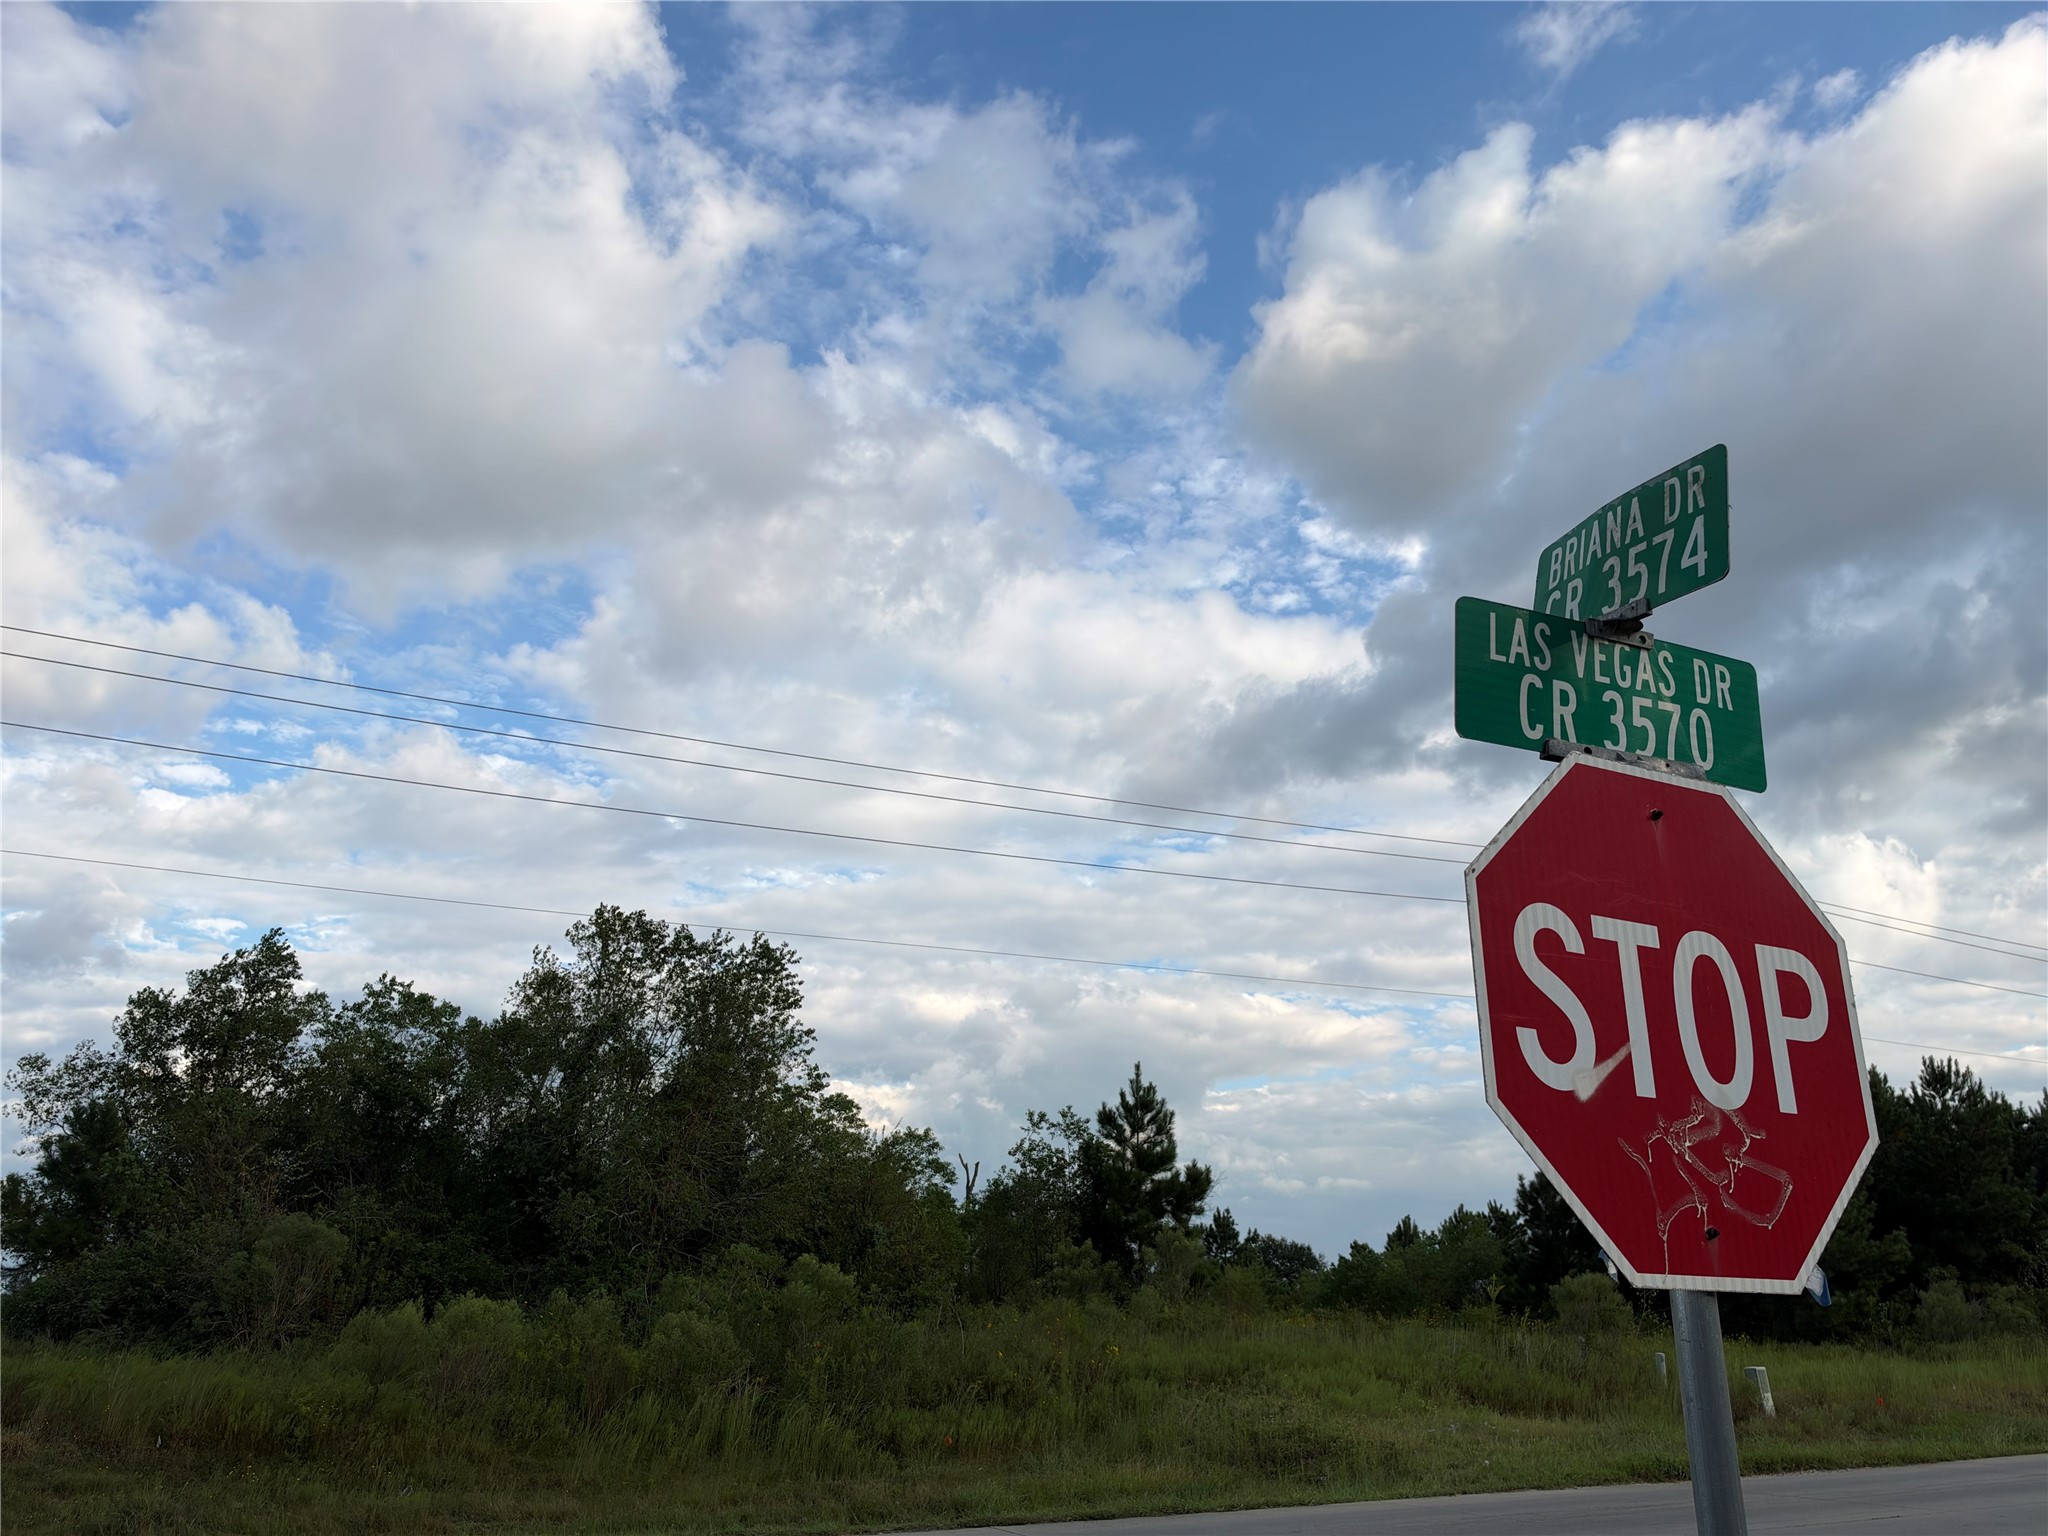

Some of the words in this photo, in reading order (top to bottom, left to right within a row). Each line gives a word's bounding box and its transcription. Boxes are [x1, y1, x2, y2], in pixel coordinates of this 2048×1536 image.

[1548, 497, 1644, 590] BRIANA
[1664, 465, 1706, 526] DR
[1602, 515, 1708, 615] 3574
[1490, 612, 1551, 671] LAS
[1571, 629, 1676, 697] VEGAS
[1693, 658, 1734, 711] DR
[1519, 673, 1577, 743] CR
[1602, 690, 1714, 771] 3570
[1513, 902, 1829, 1115] STOP
